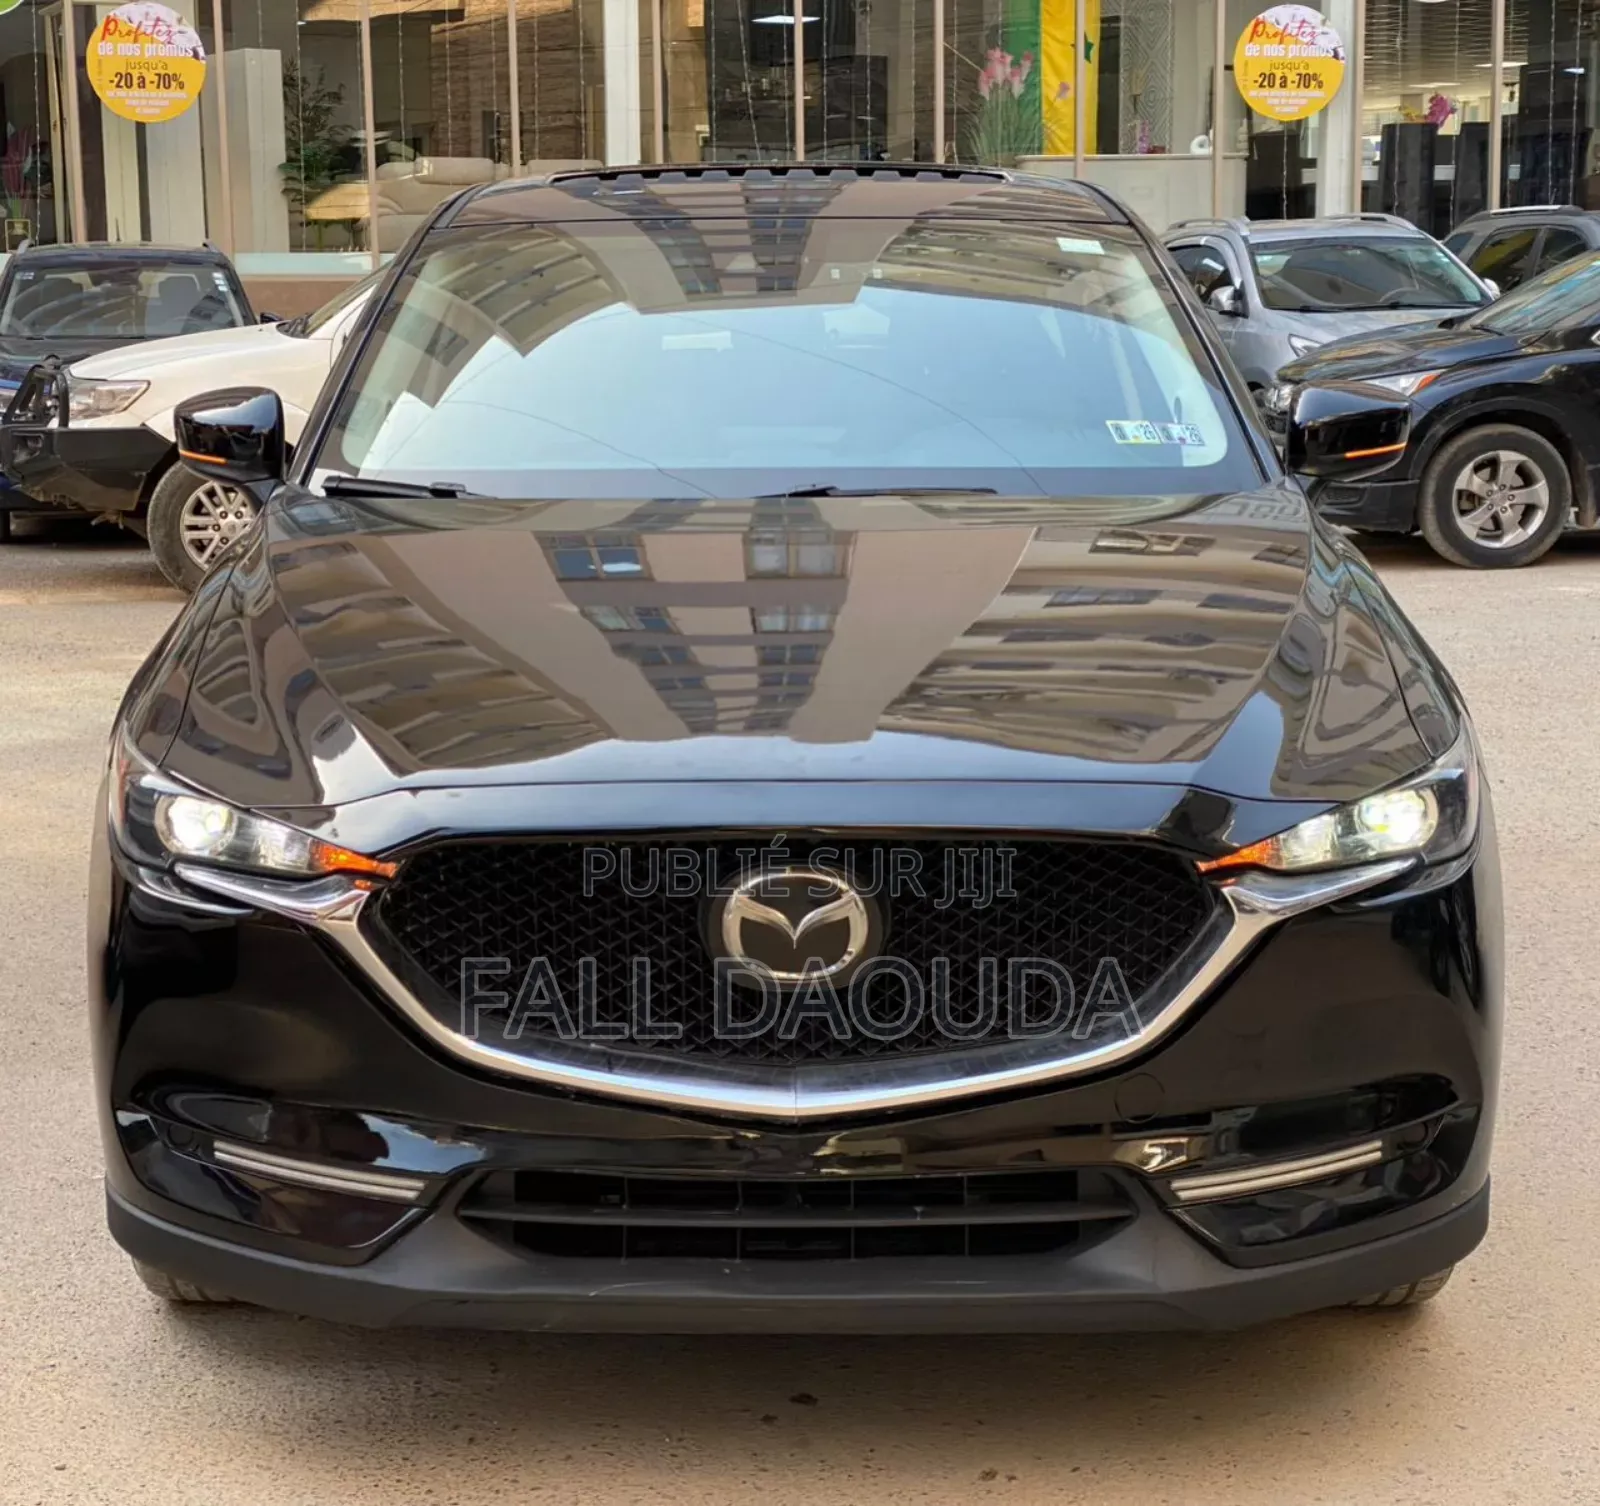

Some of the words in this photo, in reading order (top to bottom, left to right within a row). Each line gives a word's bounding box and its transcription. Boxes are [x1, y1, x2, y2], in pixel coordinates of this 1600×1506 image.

[102, 12, 177, 45] Profitez
[1249, 17, 1321, 46] Profitez
[98, 42, 113, 56] de
[118, 44, 140, 56] nos
[145, 43, 193, 58] promos
[1245, 43, 1260, 56] de
[1264, 44, 1285, 56] nos
[1288, 44, 1333, 58] promos
[109, 72, 133, 89] -20
[137, 71, 146, 89] à
[149, 73, 185, 90] -70%
[1253, 72, 1276, 89] -20
[1279, 71, 1288, 89] à
[1291, 73, 1323, 89] -70%
